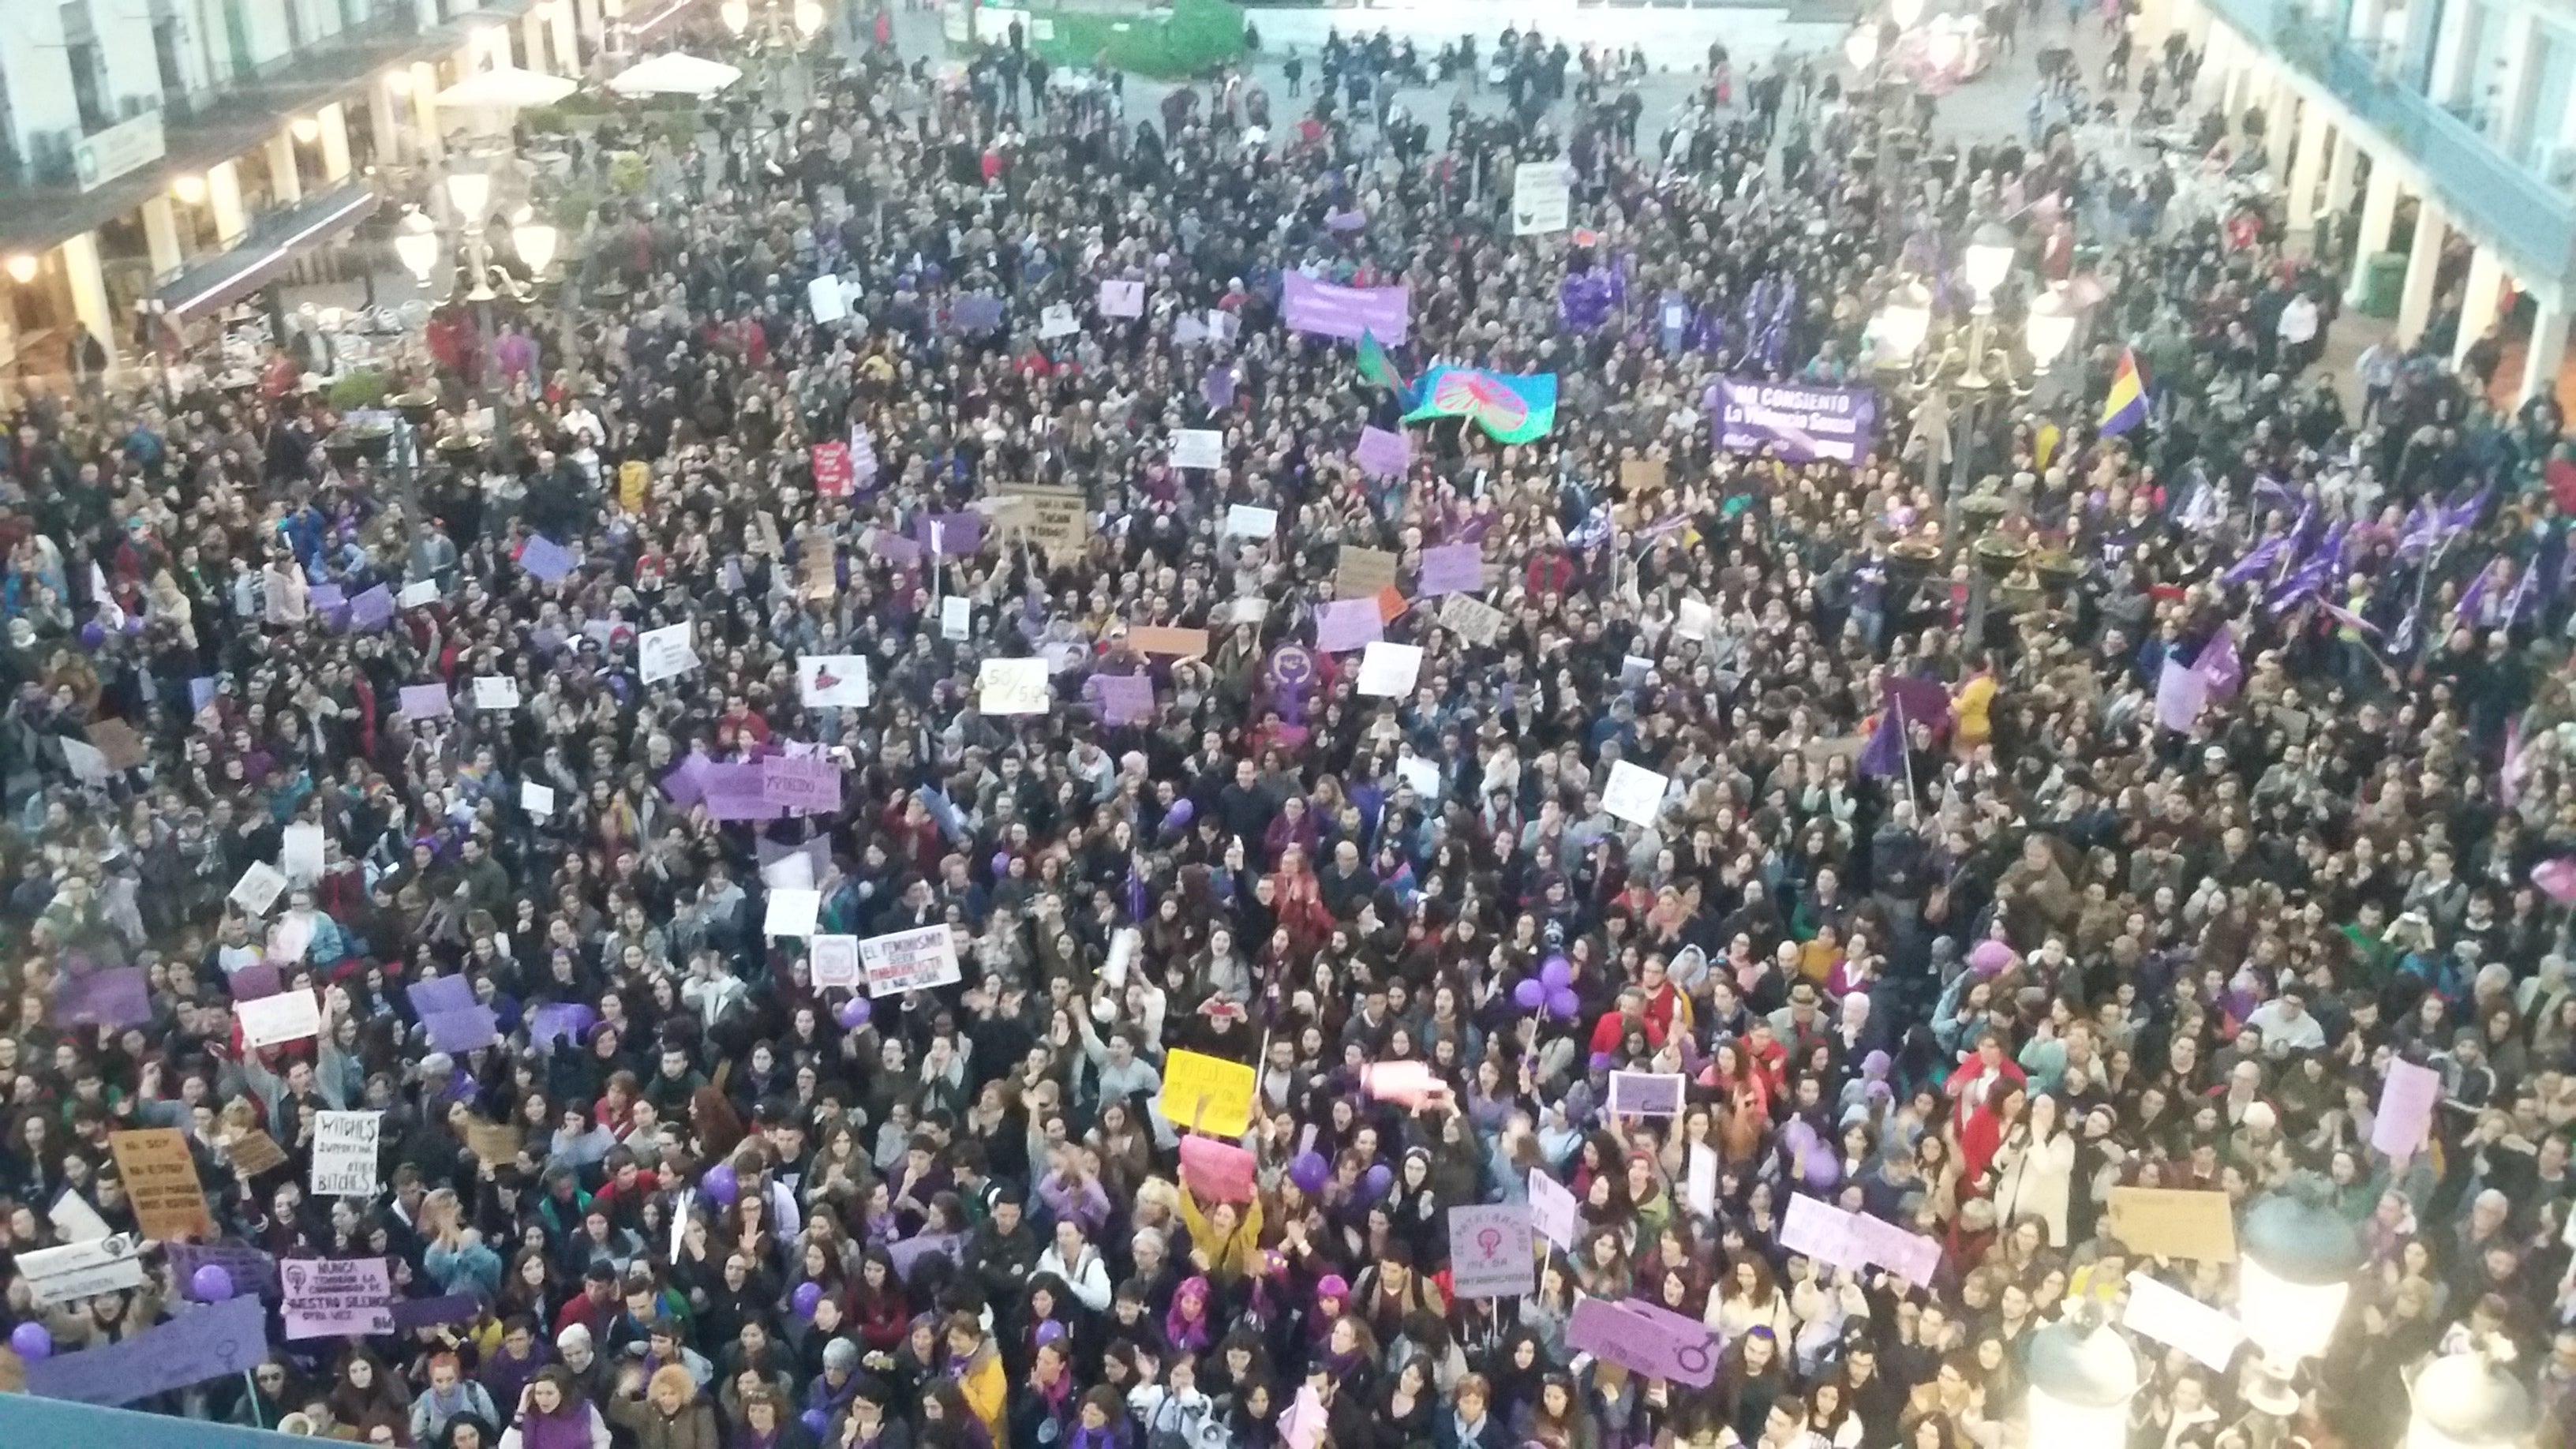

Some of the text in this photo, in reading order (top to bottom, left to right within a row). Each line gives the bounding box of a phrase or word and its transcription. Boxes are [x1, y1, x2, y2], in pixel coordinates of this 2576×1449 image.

[1735, 385, 1850, 414] NO CONSIENTO
[1724, 404, 1743, 423] La
[863, 932, 945, 960] EL FEMINISMO
[321, 1116, 376, 1143] WITCHES
[317, 1174, 370, 1193] BITCHES
[318, 1261, 357, 1275] NUNCA
